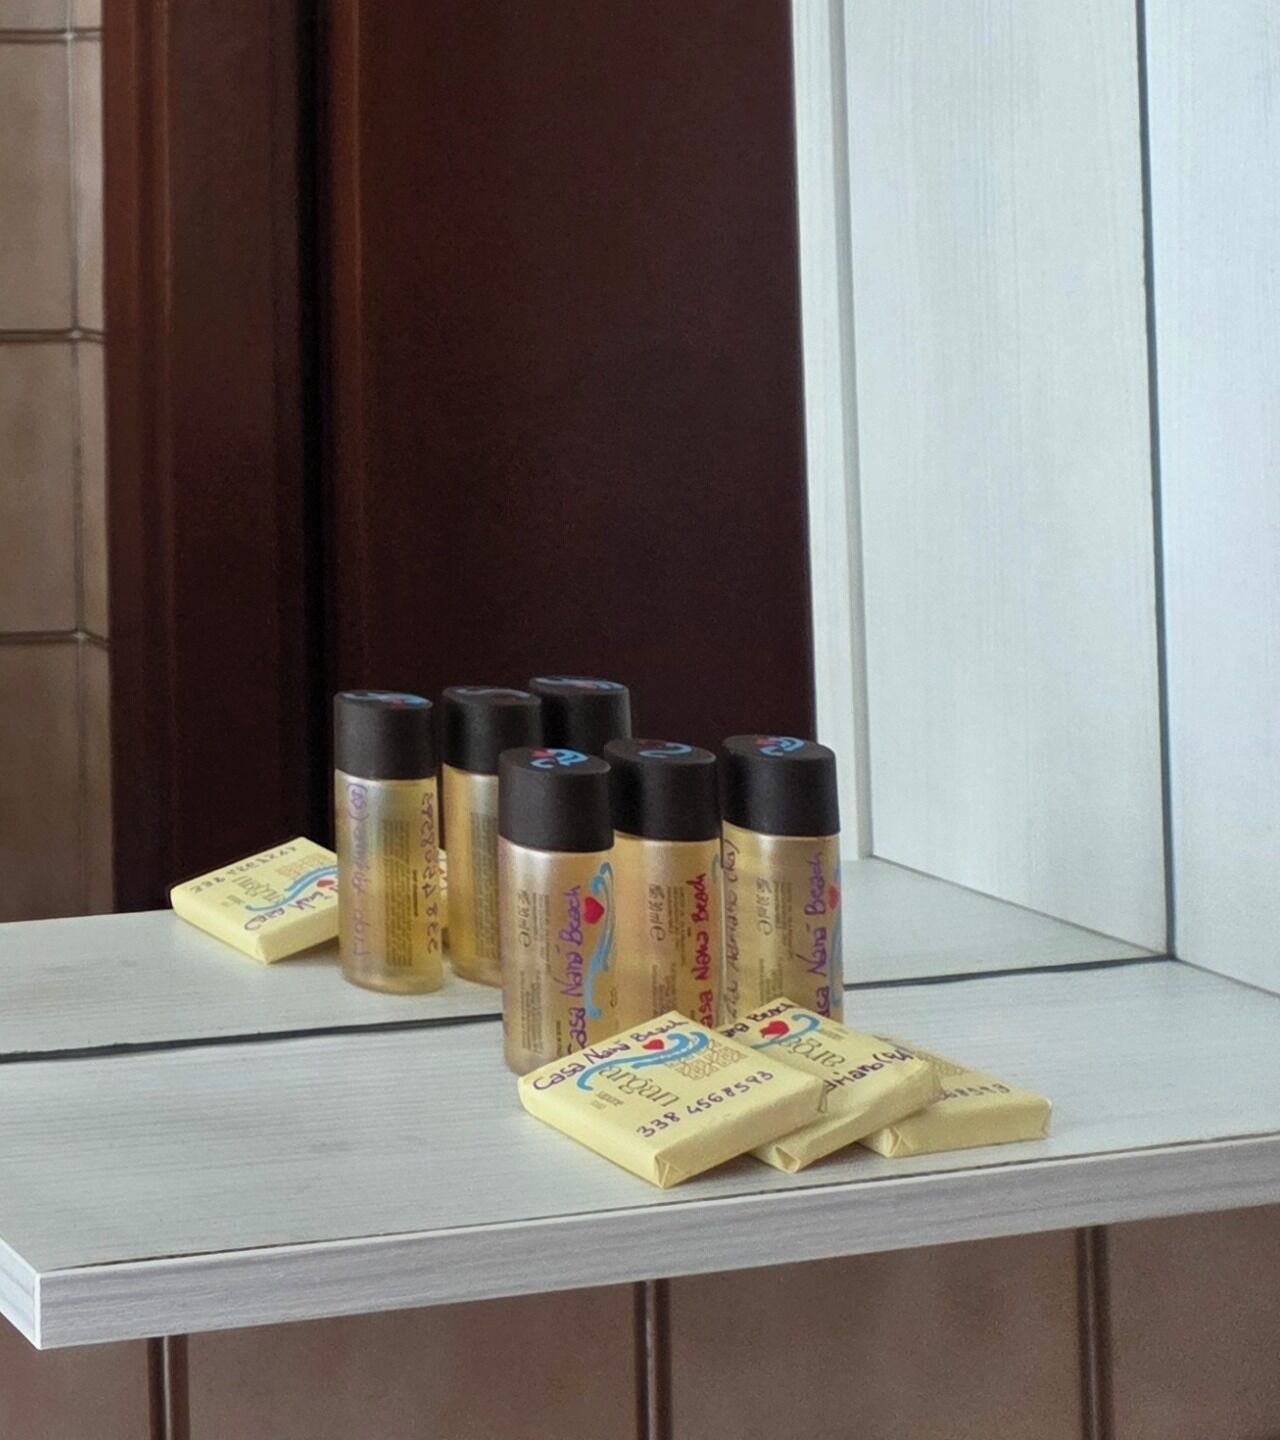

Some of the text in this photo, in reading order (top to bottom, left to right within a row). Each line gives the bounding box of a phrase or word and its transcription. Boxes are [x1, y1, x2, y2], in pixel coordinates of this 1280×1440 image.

[698, 989, 714, 1029] asa
[532, 1062, 587, 1091] Casa
[598, 1065, 680, 1108] argan
[636, 1070, 774, 1138] 338 4568593
